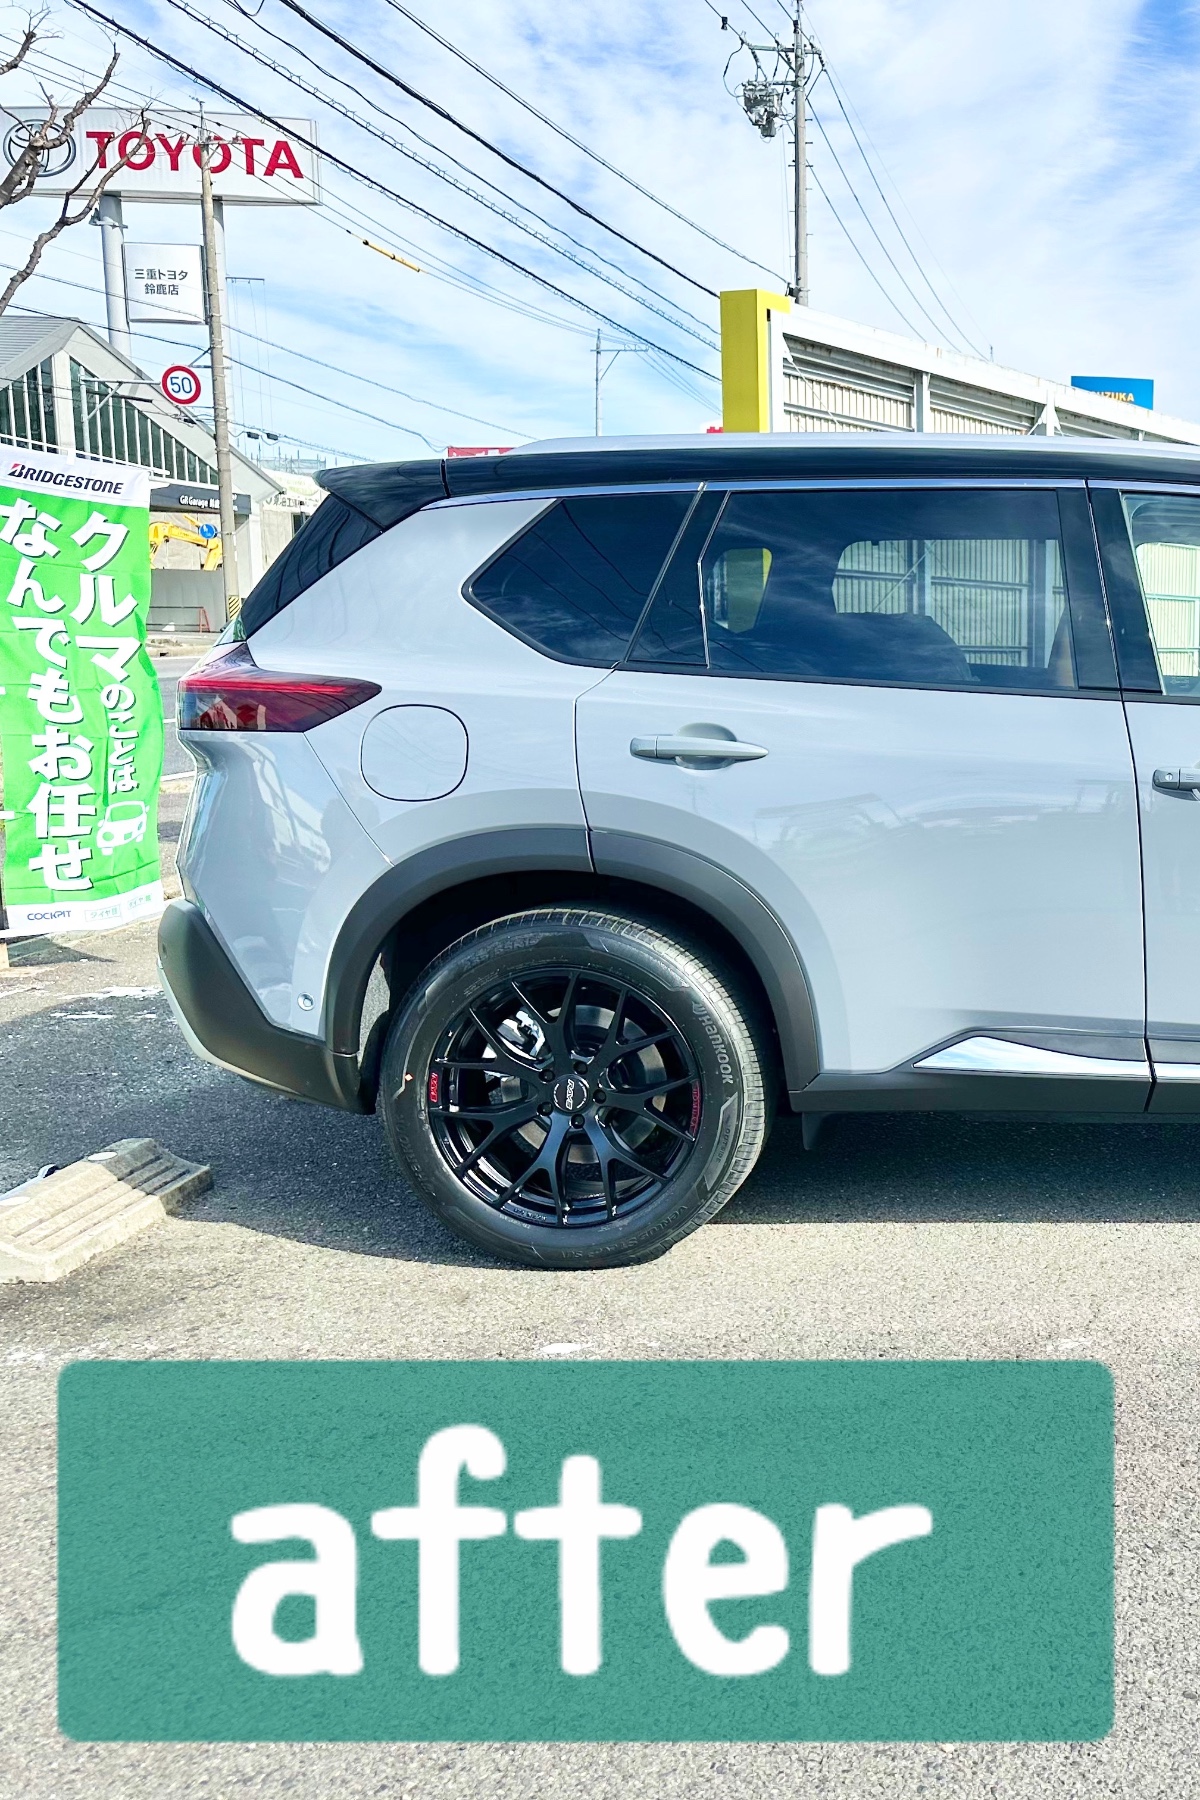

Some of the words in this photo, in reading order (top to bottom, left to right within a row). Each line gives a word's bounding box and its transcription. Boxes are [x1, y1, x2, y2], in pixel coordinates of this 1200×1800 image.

[86, 131, 304, 179] TOYOTA
[134, 268, 188, 281] 三重トヨタ
[144, 283, 179, 296] 鈴鹿店
[169, 376, 193, 395] 50
[1092, 391, 1134, 402] ZUKA
[8, 463, 124, 495] BRIDGESTONE
[0, 497, 98, 891] なんでもお任せ
[27, 910, 72, 922] COCKPIT
